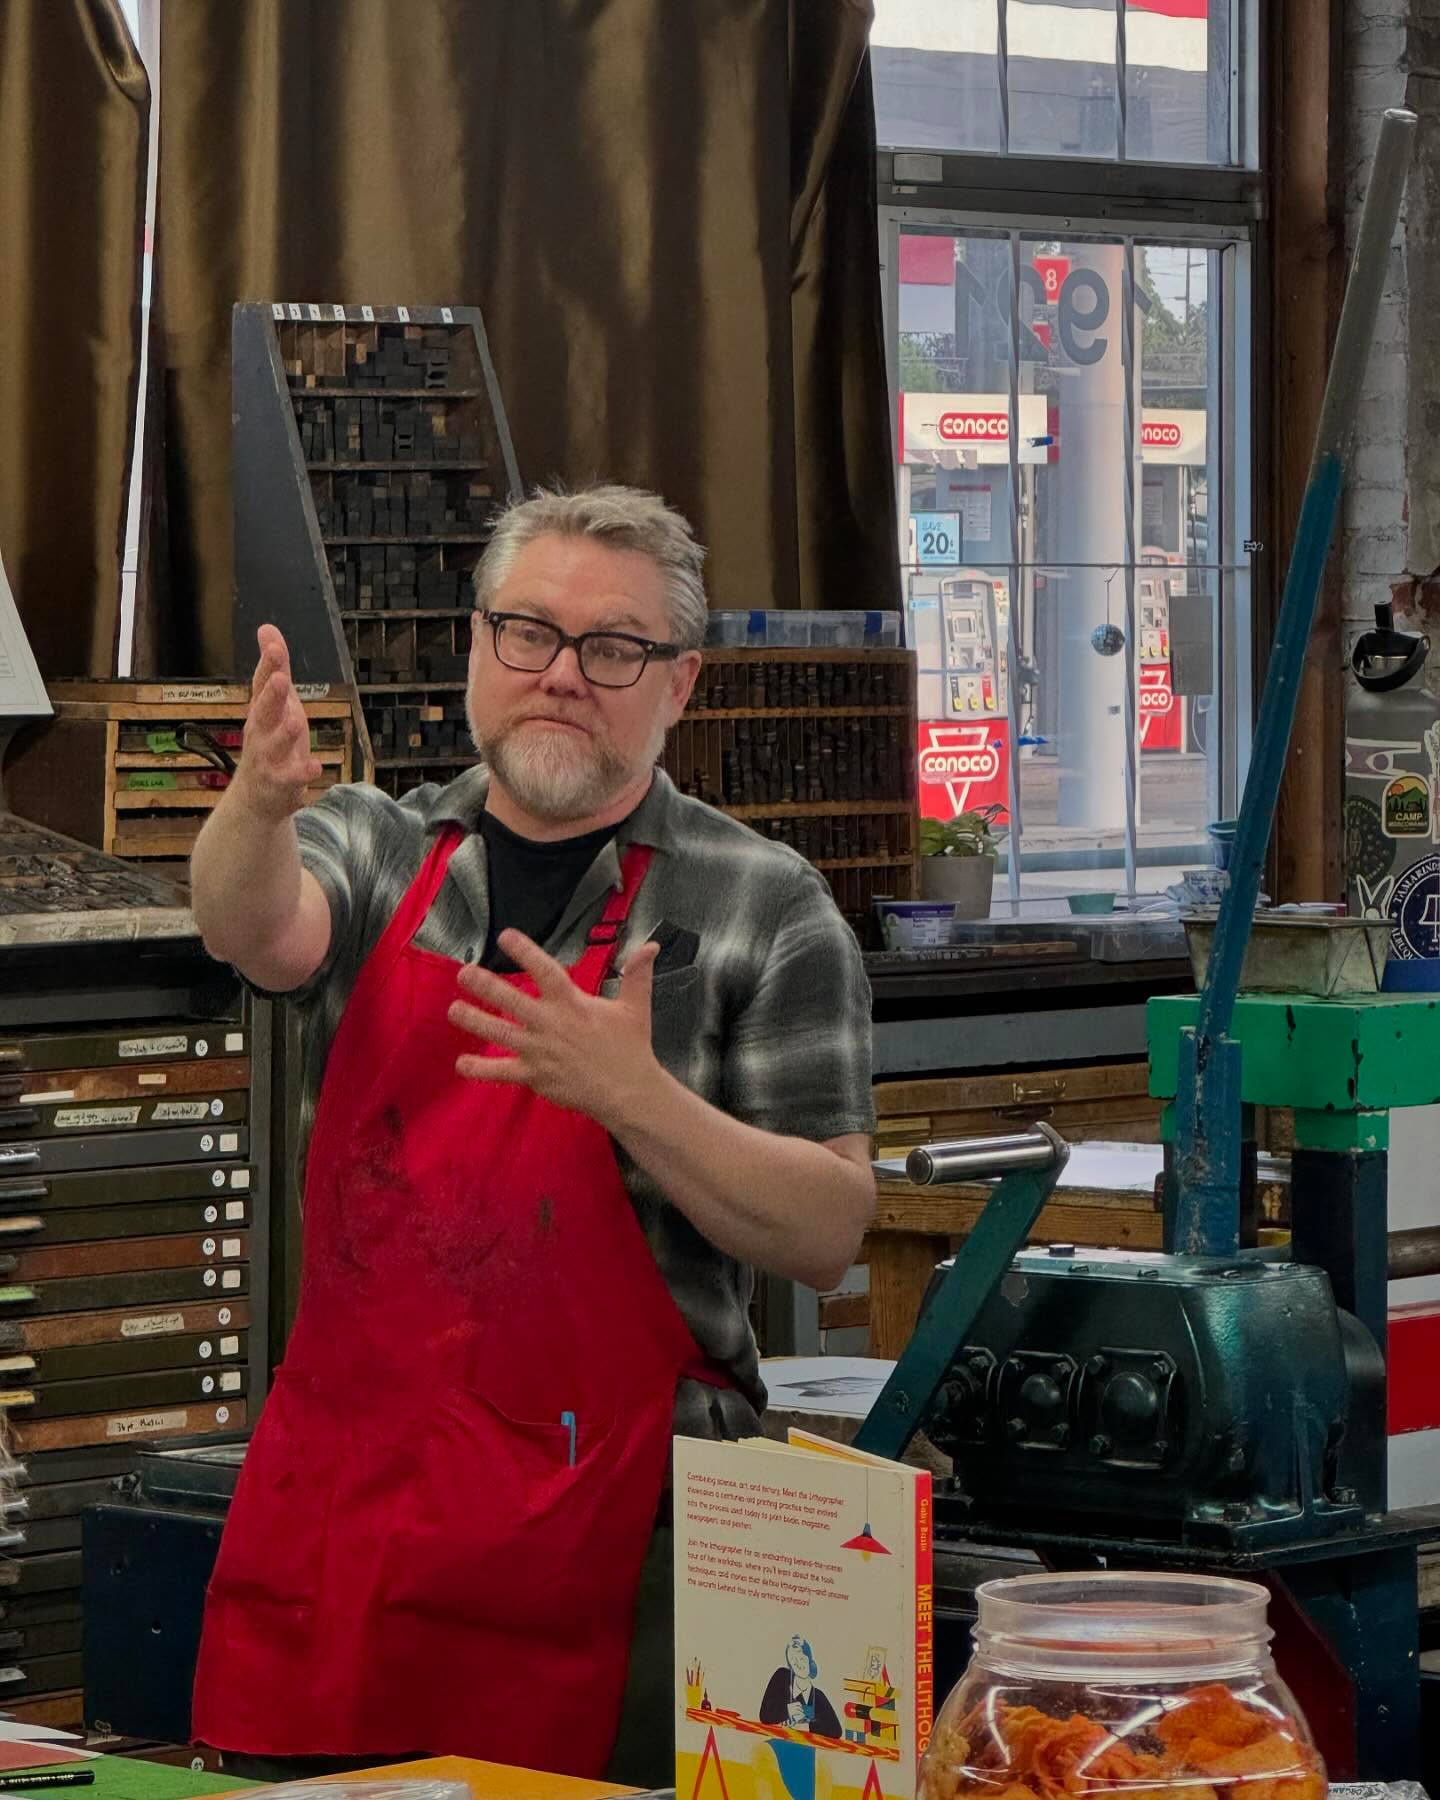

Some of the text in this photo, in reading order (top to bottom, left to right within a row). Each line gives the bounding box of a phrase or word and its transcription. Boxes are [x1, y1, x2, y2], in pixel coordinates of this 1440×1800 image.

[1046, 268, 1057, 291] 8
[1141, 427, 1178, 441] noco
[1141, 692, 1168, 706] oco
[1395, 812, 1423, 821] CAMP
[918, 1584, 932, 1758] MEET THE LITHOG
